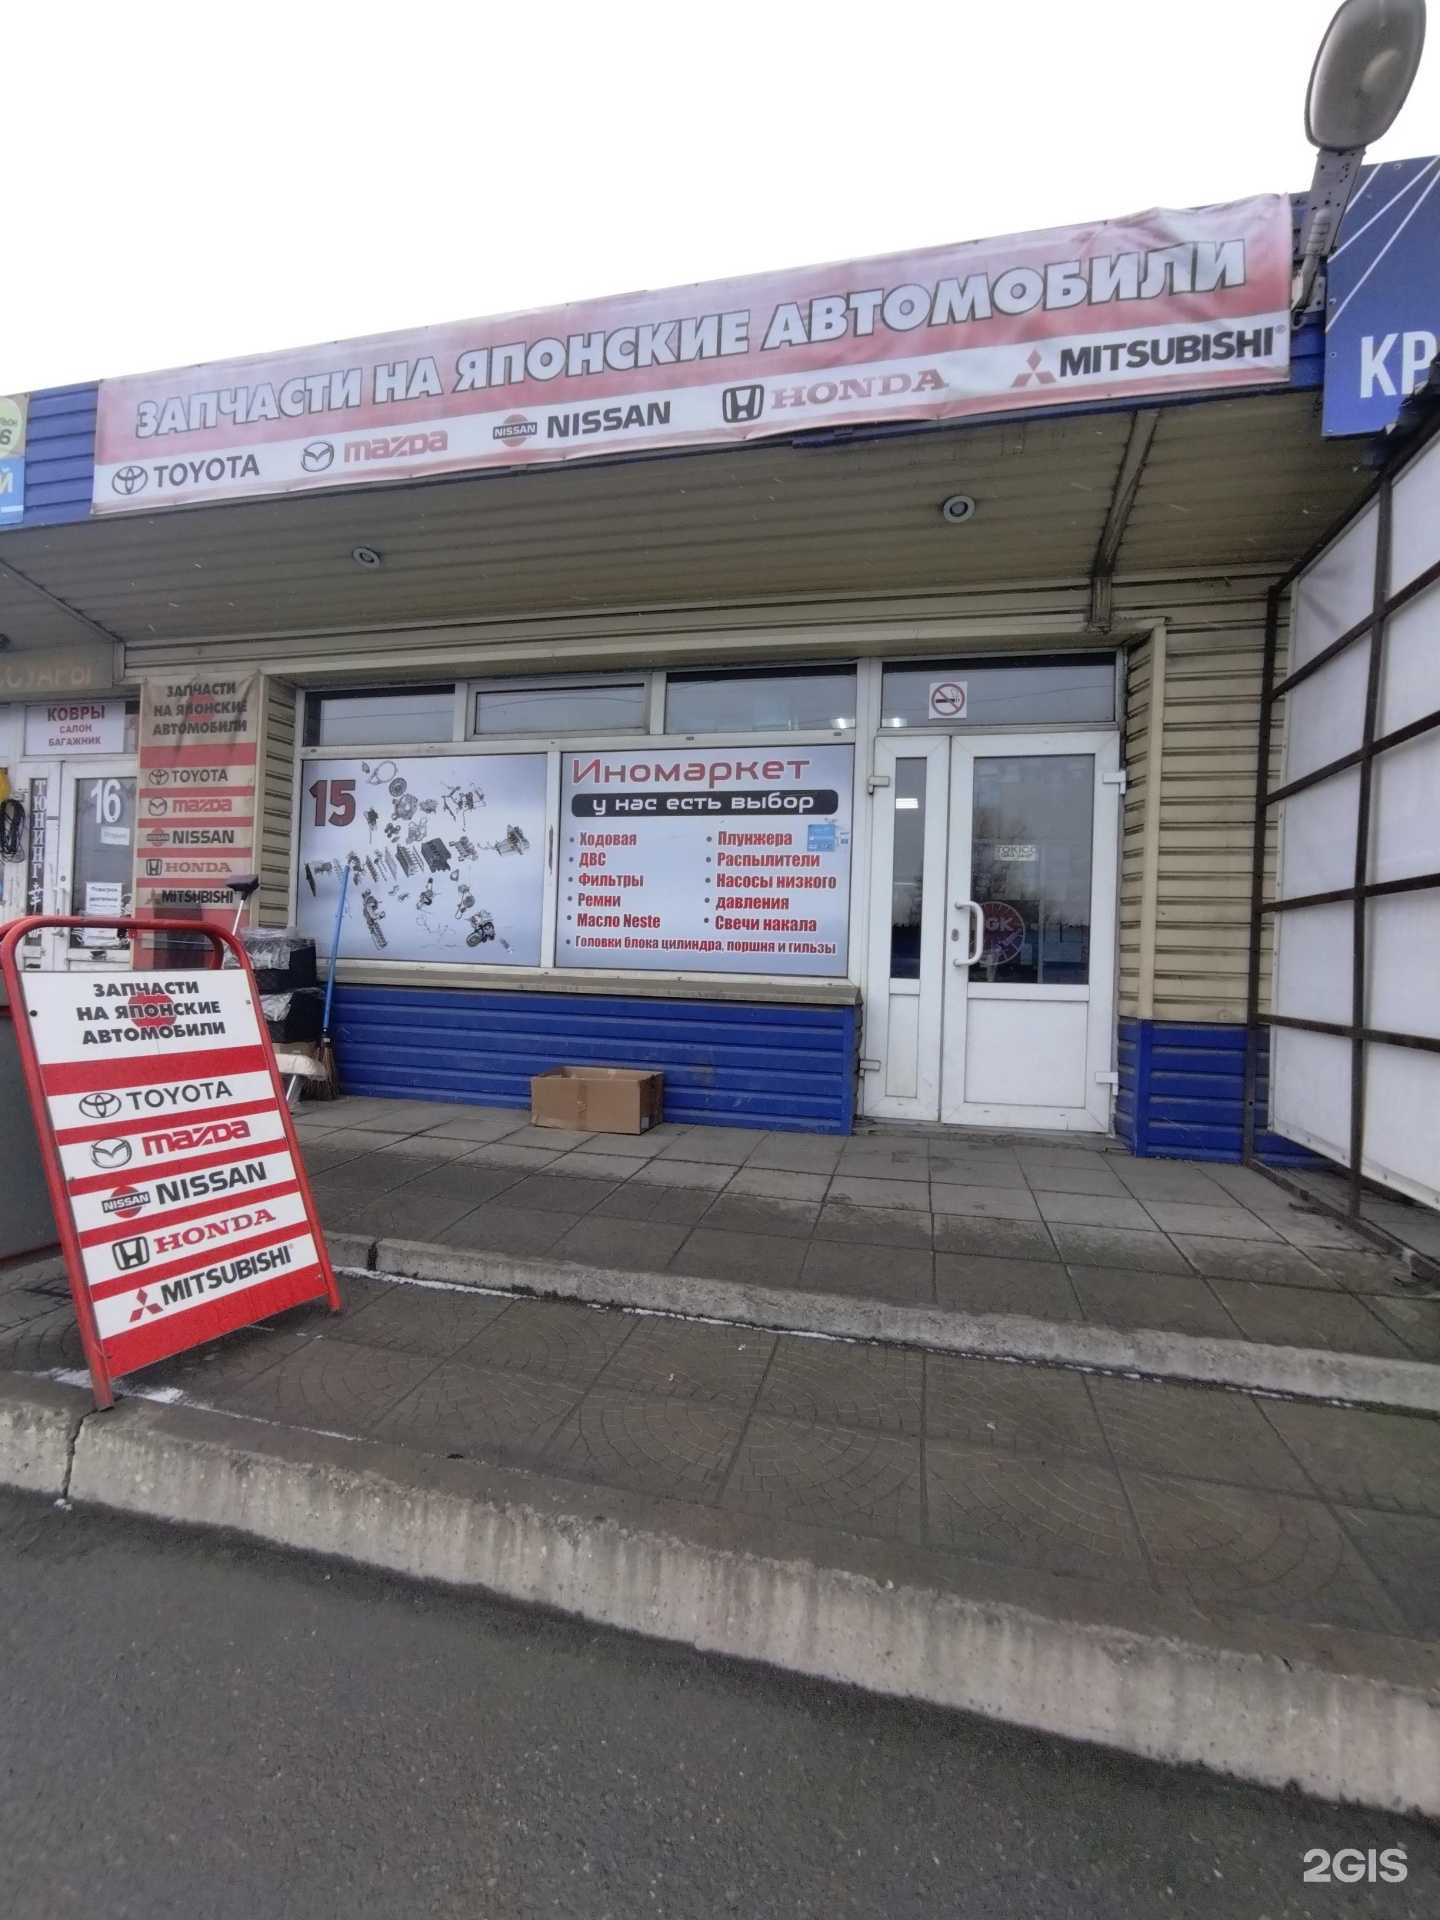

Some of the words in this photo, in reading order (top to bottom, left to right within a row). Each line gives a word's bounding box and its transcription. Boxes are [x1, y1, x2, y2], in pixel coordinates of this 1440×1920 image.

[136, 367, 362, 438] ЗАПЧАСТИ
[372, 356, 443, 405] НА
[453, 309, 750, 393] ЯПОНСКИЕ
[761, 238, 1246, 351] АВТОМОБИЛИ
[1059, 326, 1274, 378] MITSUBISHI
[770, 368, 949, 411] HONDA
[493, 421, 537, 440] NISSAN
[546, 401, 671, 439] NISSAN
[153, 453, 260, 489] TOYOTA
[167, 682, 236, 697] ЗАПЧАСТИ
[47, 704, 105, 721] КОВРЫ
[153, 704, 172, 717] НА
[175, 701, 247, 716] ЯПОНСКИЕ
[59, 724, 92, 734] САЛОН
[152, 720, 247, 736] АВТОМОБИЛИ
[48, 736, 102, 747] БАГАЖНИК
[171, 769, 228, 783] TOYOTA
[572, 758, 810, 788] Иномаркет
[90, 778, 121, 824] 16
[309, 779, 356, 827] 15
[593, 799, 606, 815] у
[615, 797, 657, 811] нас
[666, 796, 722, 811] есть
[731, 792, 814, 813] выбор
[172, 830, 234, 844] NISSAN
[579, 832, 637, 847] Ходовая
[718, 831, 793, 847] Плунжера
[165, 862, 232, 873] HONDA
[579, 852, 606, 868] ДВС
[717, 852, 820, 868] Распылители
[578, 872, 644, 888] Фильтры
[716, 873, 773, 889] Насосы
[776, 874, 837, 889] низкого
[577, 892, 621, 907] Ремни
[715, 895, 790, 911] давления
[577, 913, 620, 928] Масло
[623, 913, 661, 929] Neste
[715, 915, 760, 931] Свечи
[763, 916, 817, 932] накала
[575, 935, 623, 948] Головки
[624, 936, 659, 950] блока
[93, 981, 200, 998] ЗАПЧАСТИ
[77, 1005, 111, 1021] НА
[115, 1000, 222, 1019] ЯПОНСКИЕ
[82, 1021, 226, 1045] АВТОМОБИЛИ
[126, 1080, 233, 1110] TOYOTA
[102, 1192, 150, 1213] NISSAN
[156, 1161, 267, 1204] NISSAN
[155, 1207, 276, 1254] HONDA
[161, 1245, 292, 1305] MITSUBISHI
